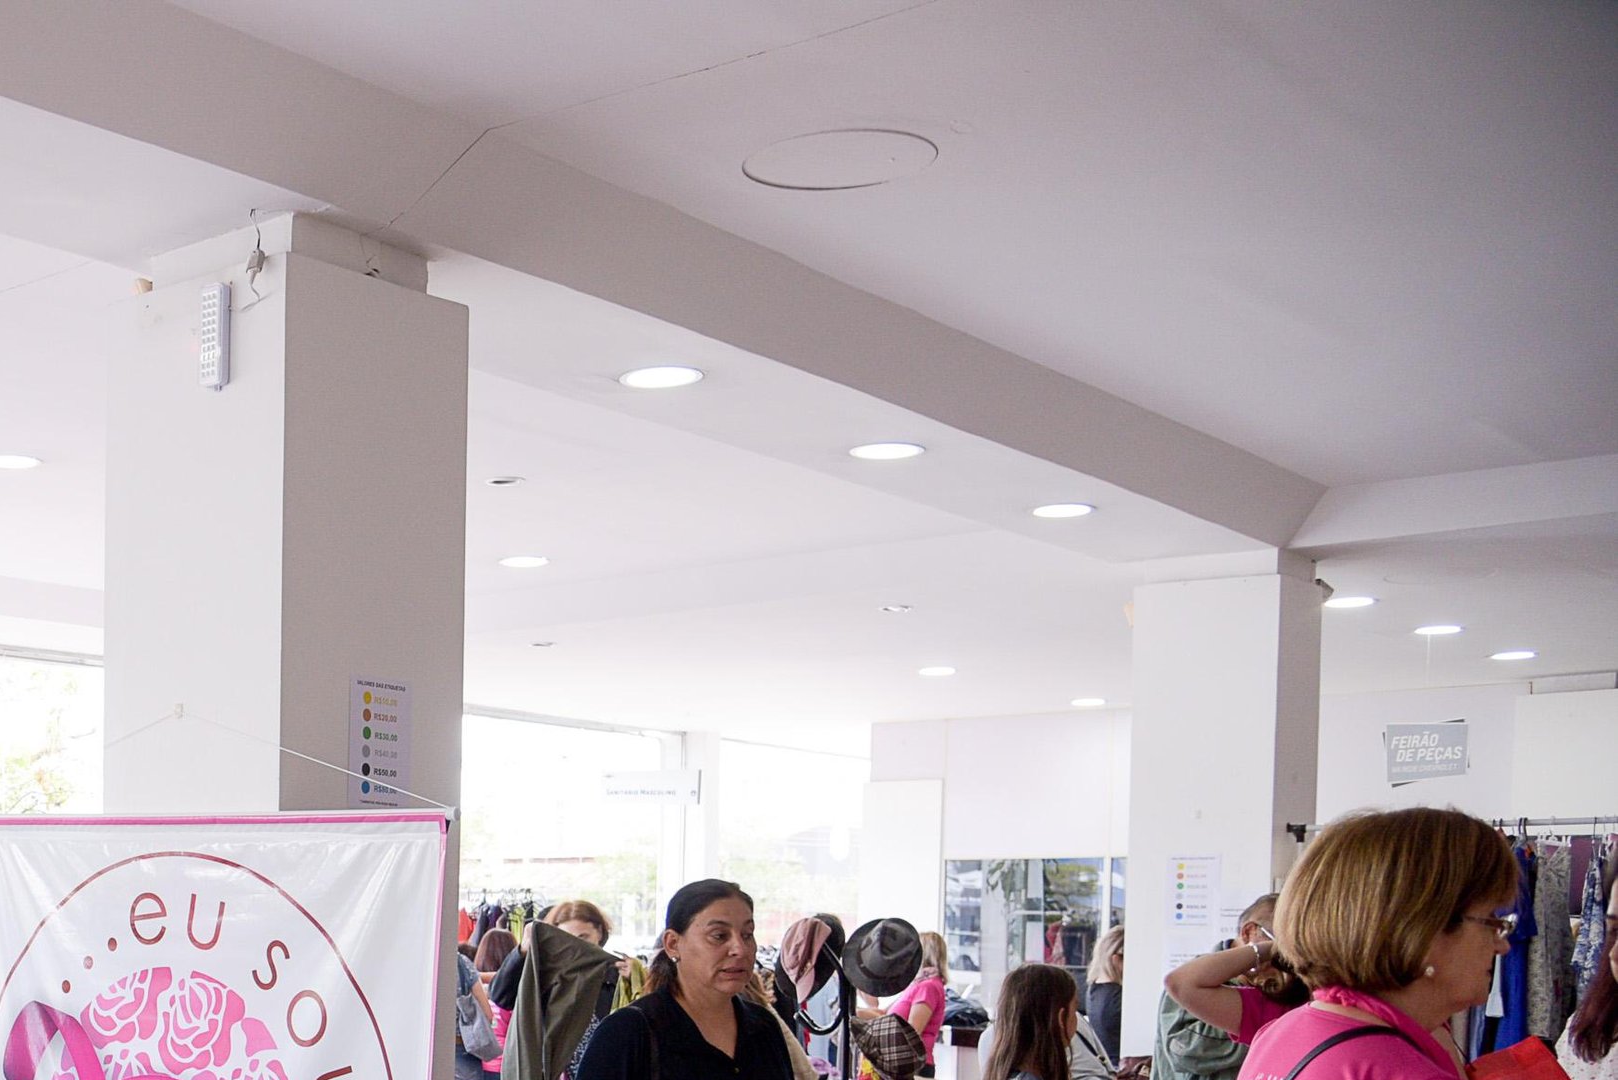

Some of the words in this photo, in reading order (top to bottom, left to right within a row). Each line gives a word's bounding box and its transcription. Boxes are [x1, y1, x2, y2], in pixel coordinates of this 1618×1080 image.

[373, 712, 397, 723] R$20,00
[374, 731, 398, 742] R$30,00
[1391, 731, 1439, 750] FEIRÃO
[1395, 748, 1416, 762] DE
[1416, 746, 1463, 764] PEÇAS
